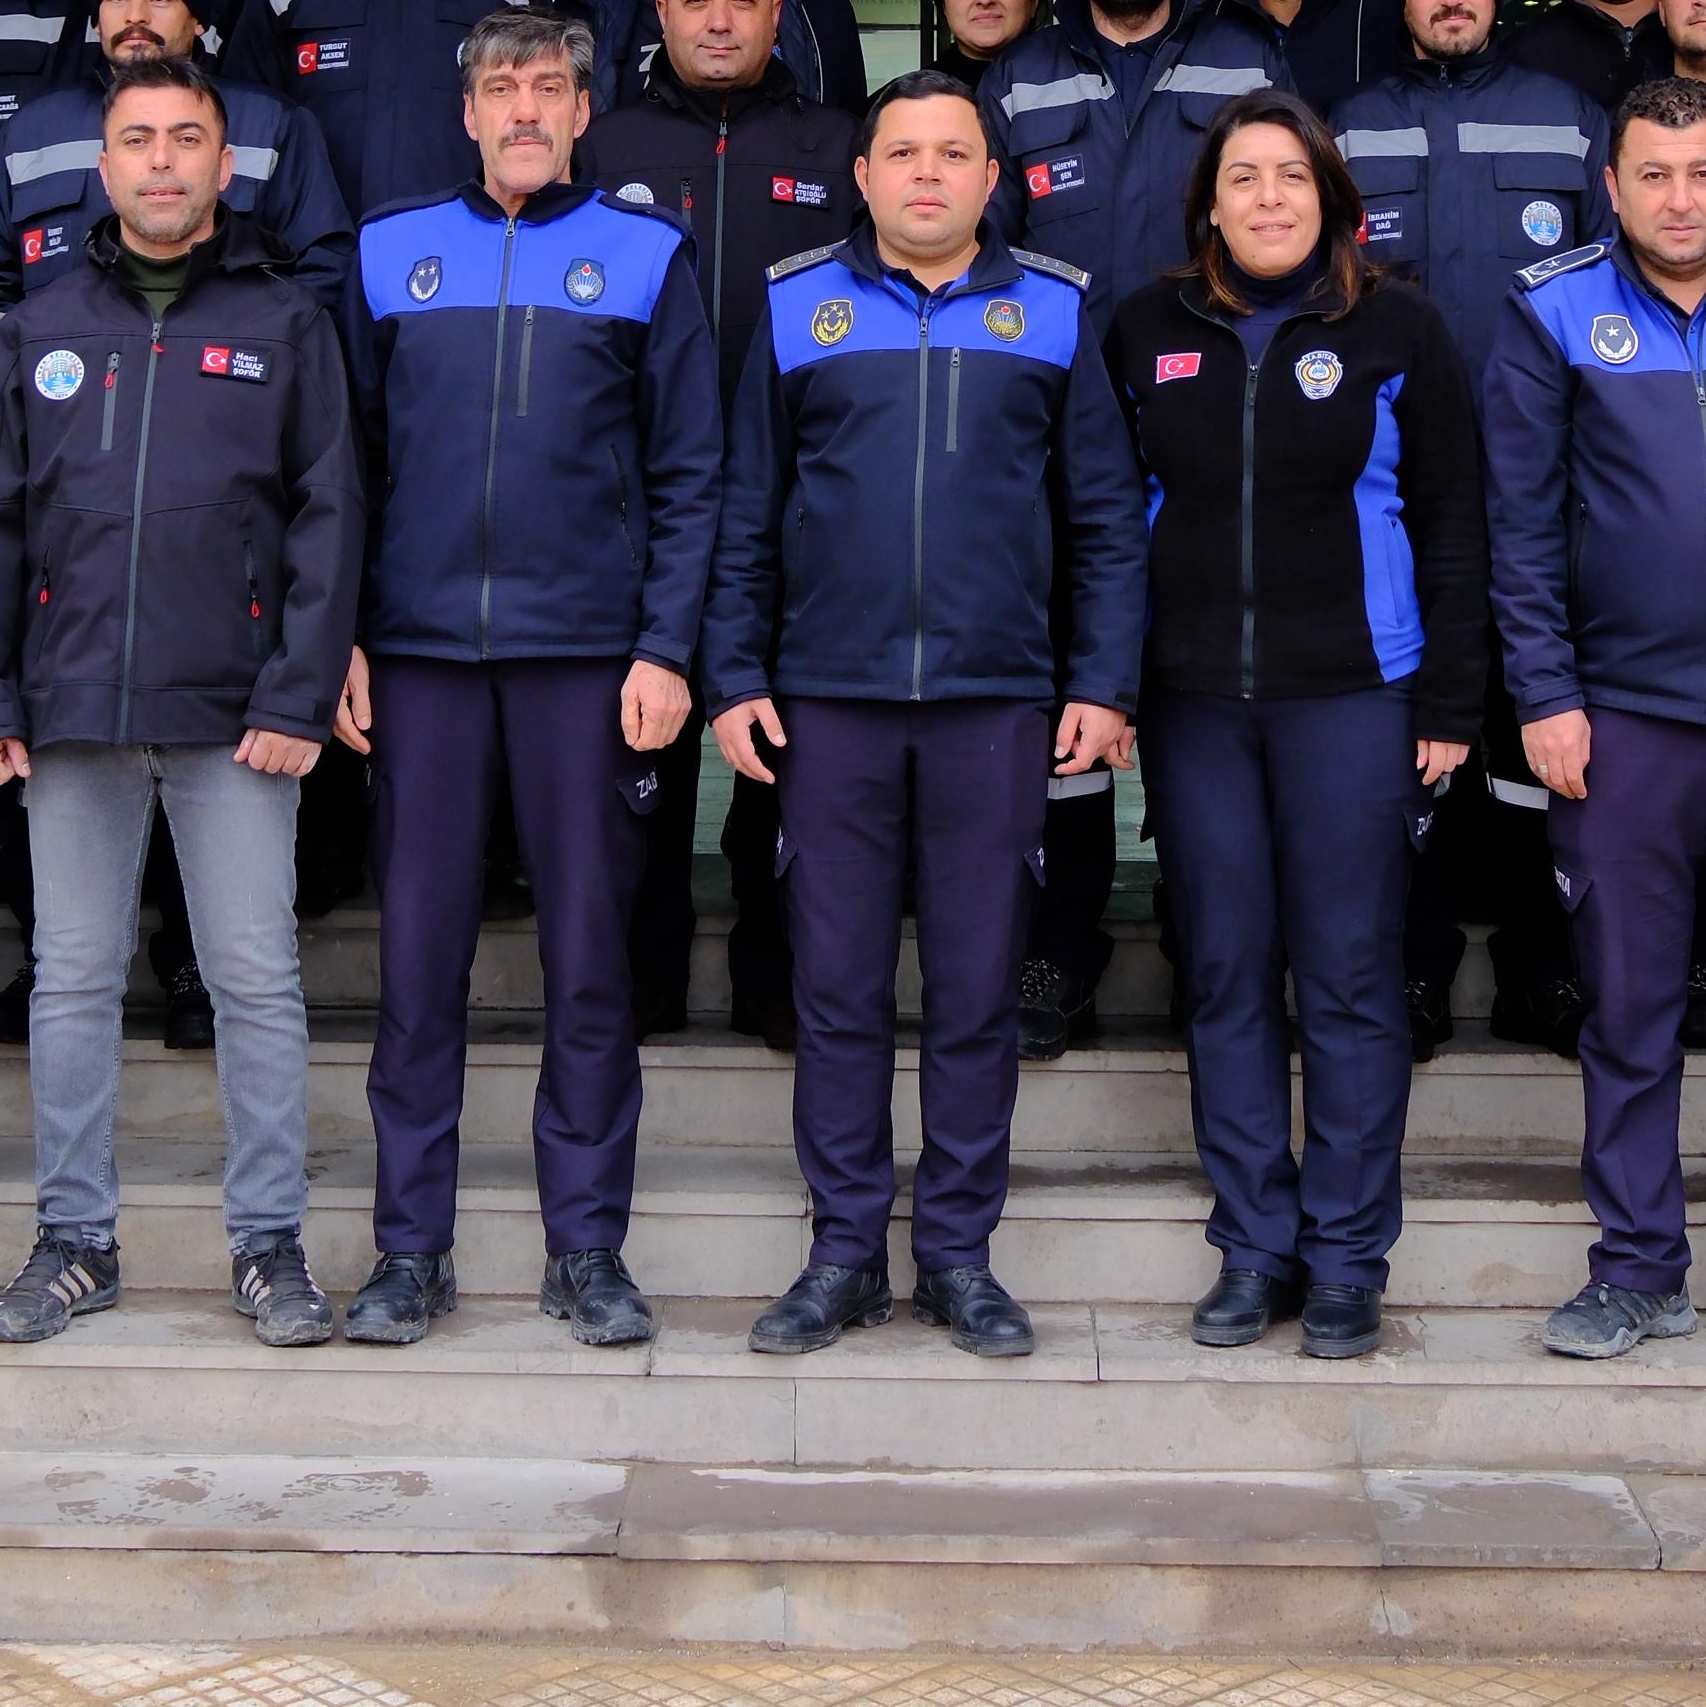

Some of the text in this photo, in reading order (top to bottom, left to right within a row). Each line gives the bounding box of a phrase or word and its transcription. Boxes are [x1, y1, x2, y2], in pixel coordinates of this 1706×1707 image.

[1052, 159, 1078, 173] HÜSEYİN
[796, 181, 824, 191] Serdar
[1368, 210, 1399, 222] İBRAHİM
[1375, 220, 1391, 230] DAĞ
[235, 352, 258, 361] Hacı
[232, 358, 264, 372] YILMAZ
[233, 367, 261, 378] ŞOFÖR
[636, 771, 658, 799] ZAB
